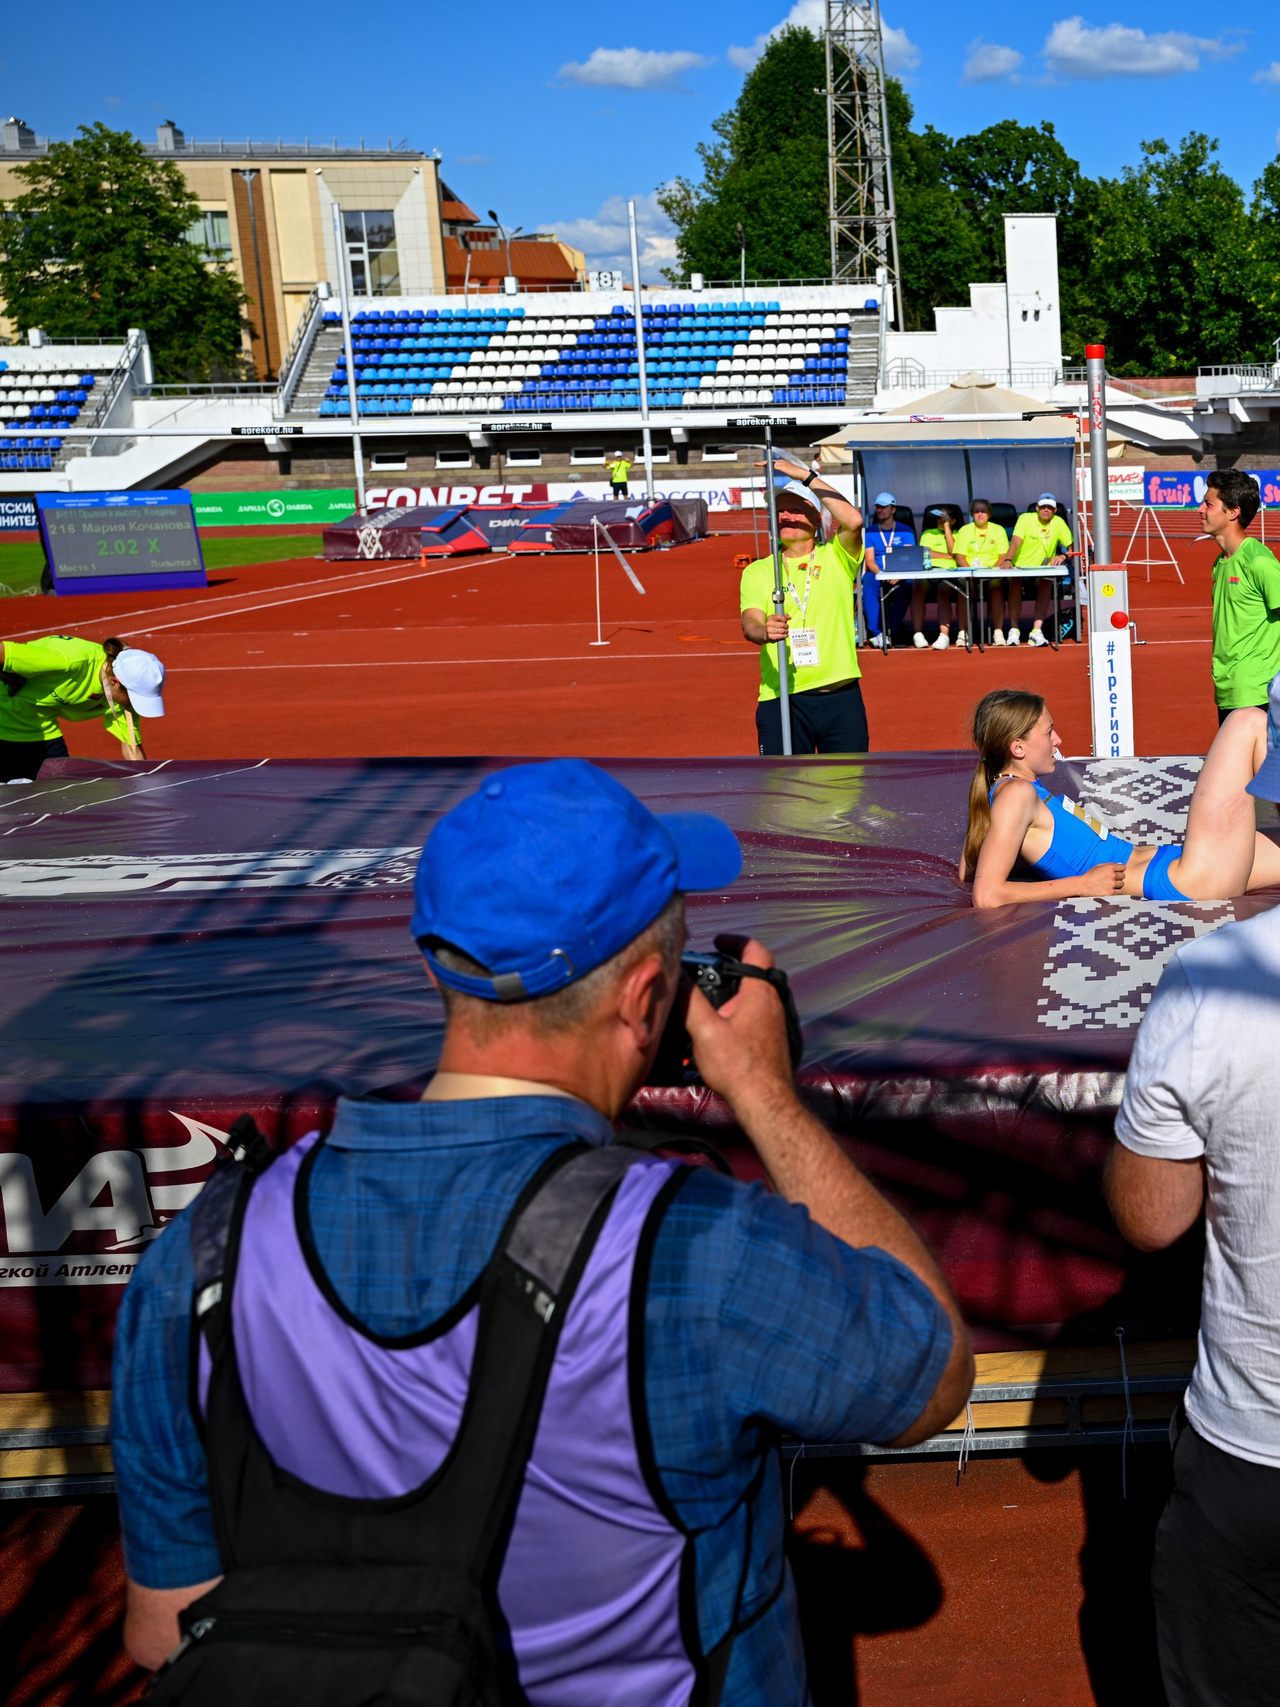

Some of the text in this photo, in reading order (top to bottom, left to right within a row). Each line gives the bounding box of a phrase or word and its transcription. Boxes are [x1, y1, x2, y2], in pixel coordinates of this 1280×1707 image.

[600, 271, 612, 287] 8
[736, 418, 788, 426] aprekord.hu
[241, 427, 294, 435] aprekord.hu
[1148, 476, 1191, 503] fruit
[364, 485, 533, 510] FONBET
[50, 521, 191, 535] 216 Мария Кочанова
[97, 540, 139, 556] 2.02
[59, 564, 89, 573] Место
[151, 560, 191, 568] Попытка
[1106, 640, 1120, 757] #1регион
